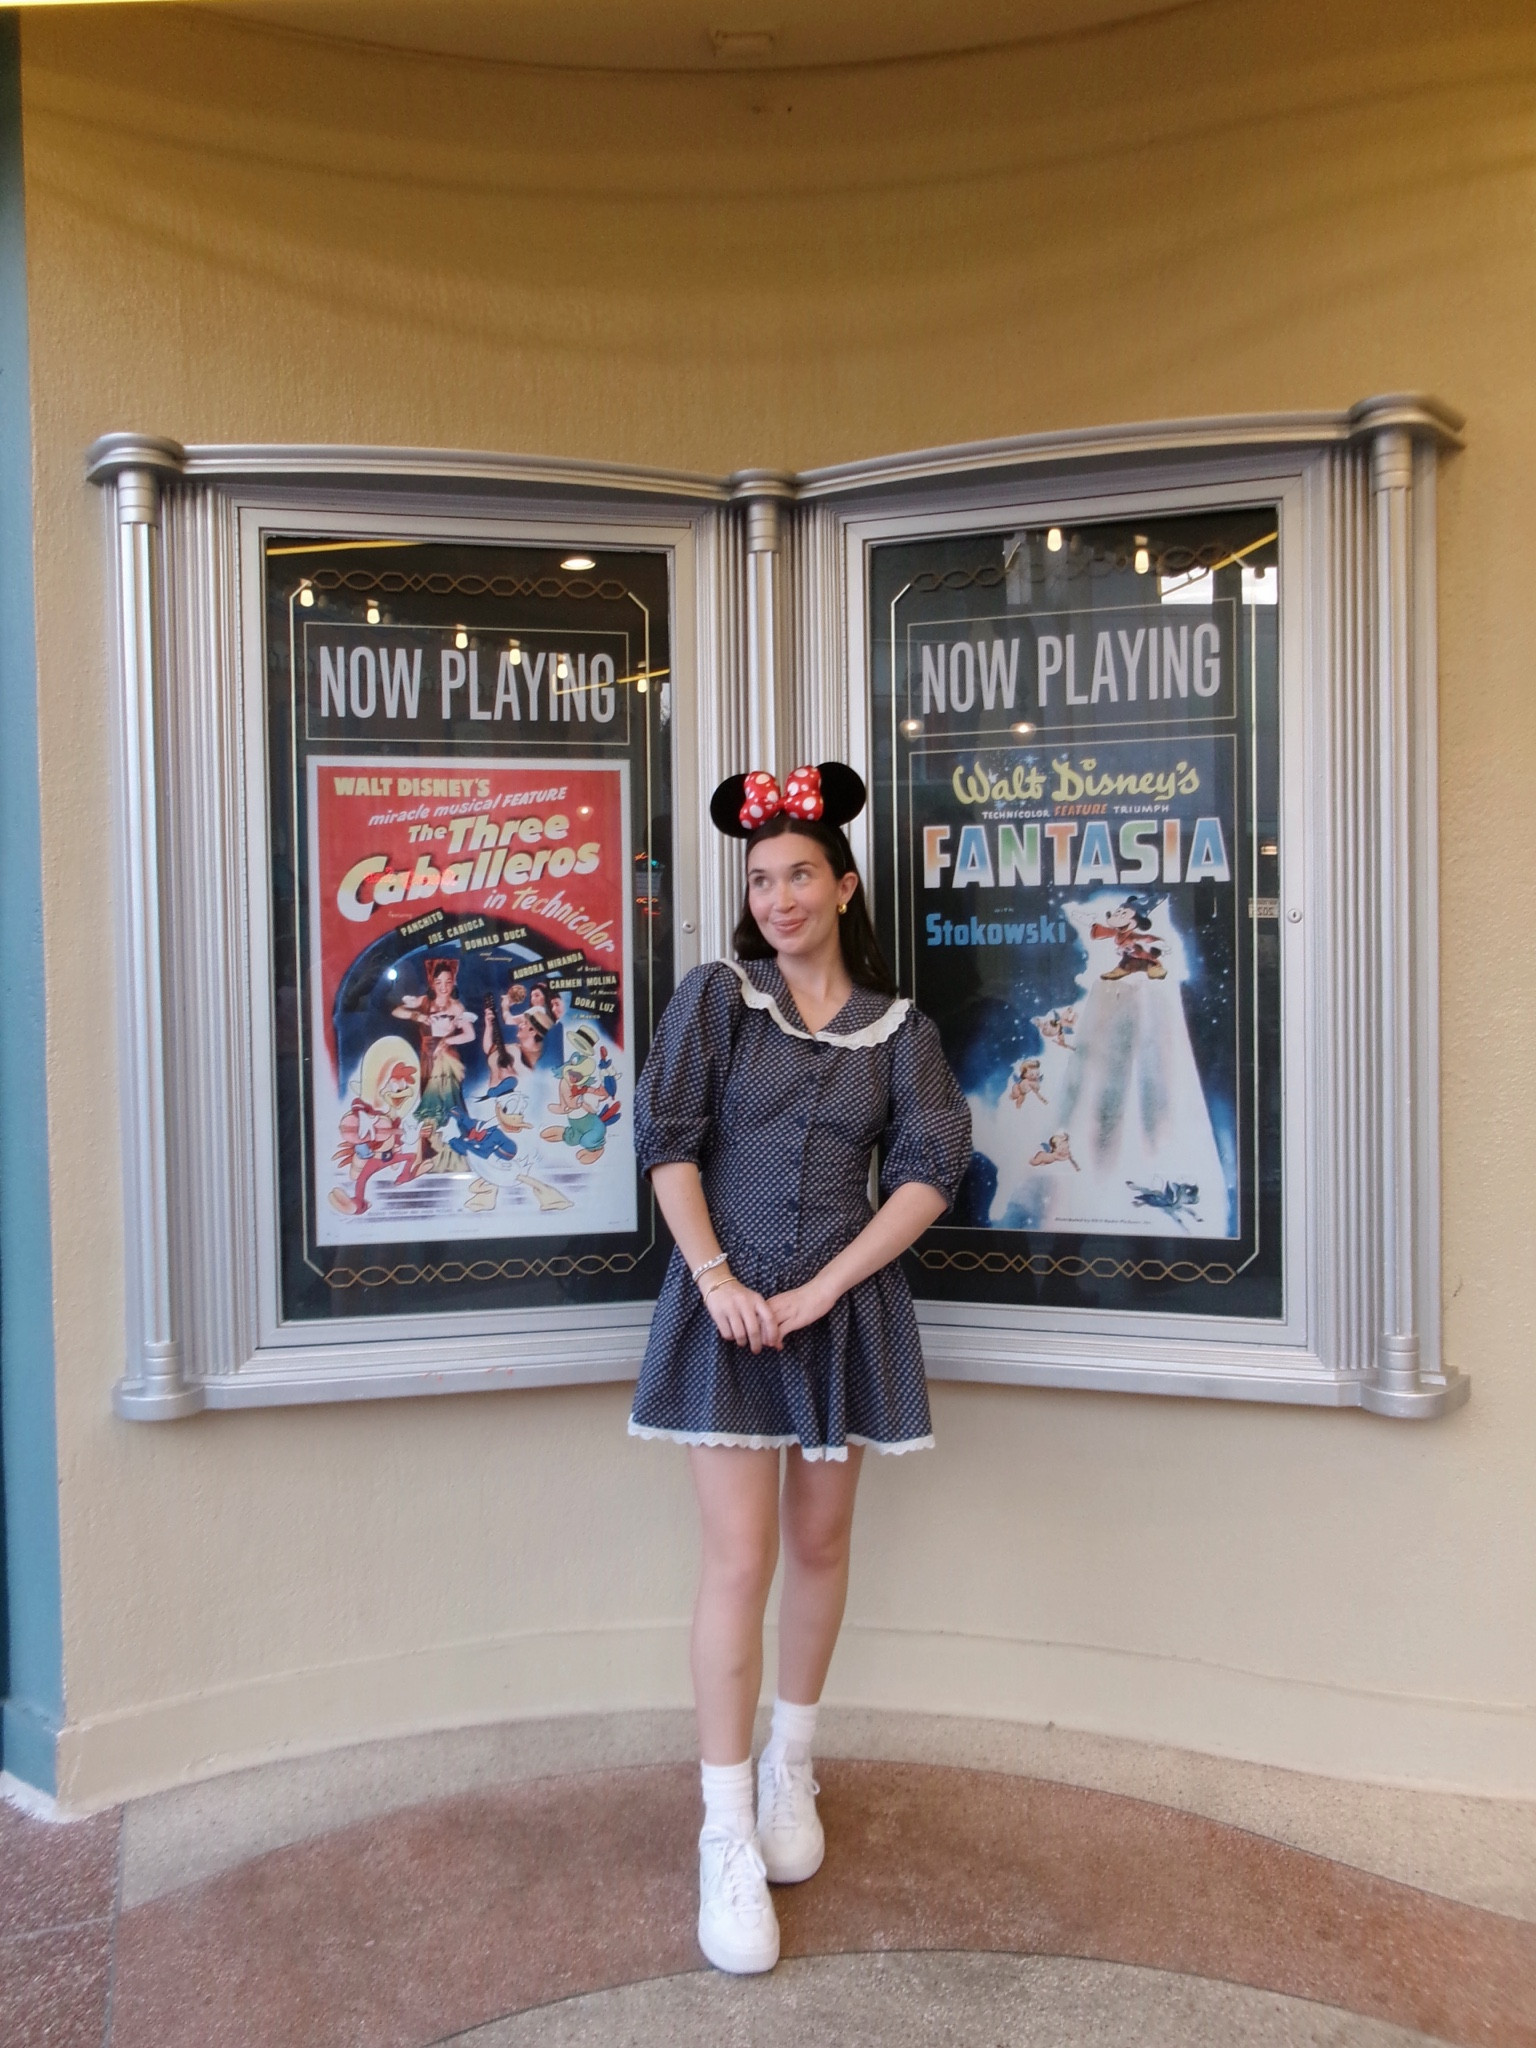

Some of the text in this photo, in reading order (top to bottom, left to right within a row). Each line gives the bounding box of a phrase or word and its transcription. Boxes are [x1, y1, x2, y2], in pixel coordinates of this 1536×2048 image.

[920, 621, 1222, 714] NOW PLAYING
[320, 645, 616, 723] NOW PLAYING
[333, 777, 490, 798] WALT DISNEY'S
[952, 757, 1200, 804] Walt Disney's
[368, 786, 568, 827] miracle musical FEATURE
[982, 803, 1170, 820] TECHNICOLOR FEATURE TRIUMPH
[408, 814, 571, 855] The Three
[922, 817, 1231, 889] FANTASIA
[336, 842, 601, 923] Caballeros
[483, 889, 507, 909] in
[400, 911, 444, 937] PANCHITO
[428, 917, 485, 945] JOE CARIOCA
[925, 912, 1067, 947] Stokowski
[464, 928, 527, 951] DONALD DUCK
[513, 952, 584, 980] AURORA MIRANDA
[549, 975, 617, 990] CARMEN MOLINA
[574, 997, 615, 1013] DORA LUZ
